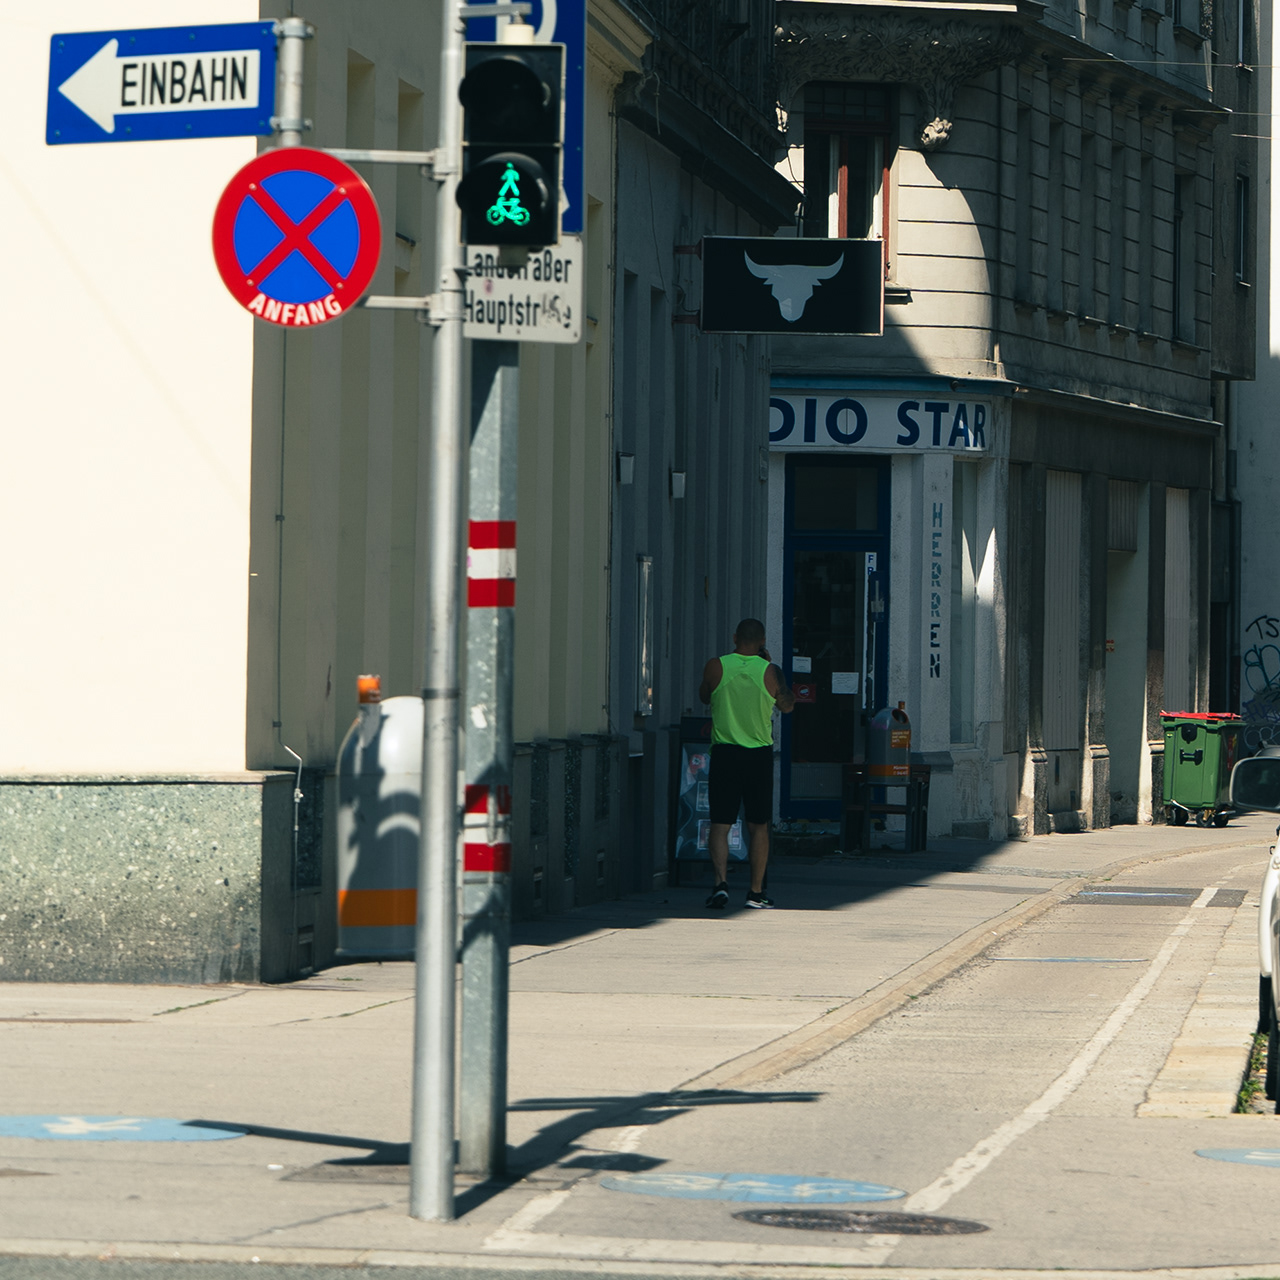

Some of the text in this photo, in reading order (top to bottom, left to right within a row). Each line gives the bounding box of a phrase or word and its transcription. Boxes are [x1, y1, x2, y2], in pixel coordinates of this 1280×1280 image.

[121, 56, 248, 107] EINBAHN
[248, 292, 343, 326] ANFANG
[896, 400, 986, 448] STAR
